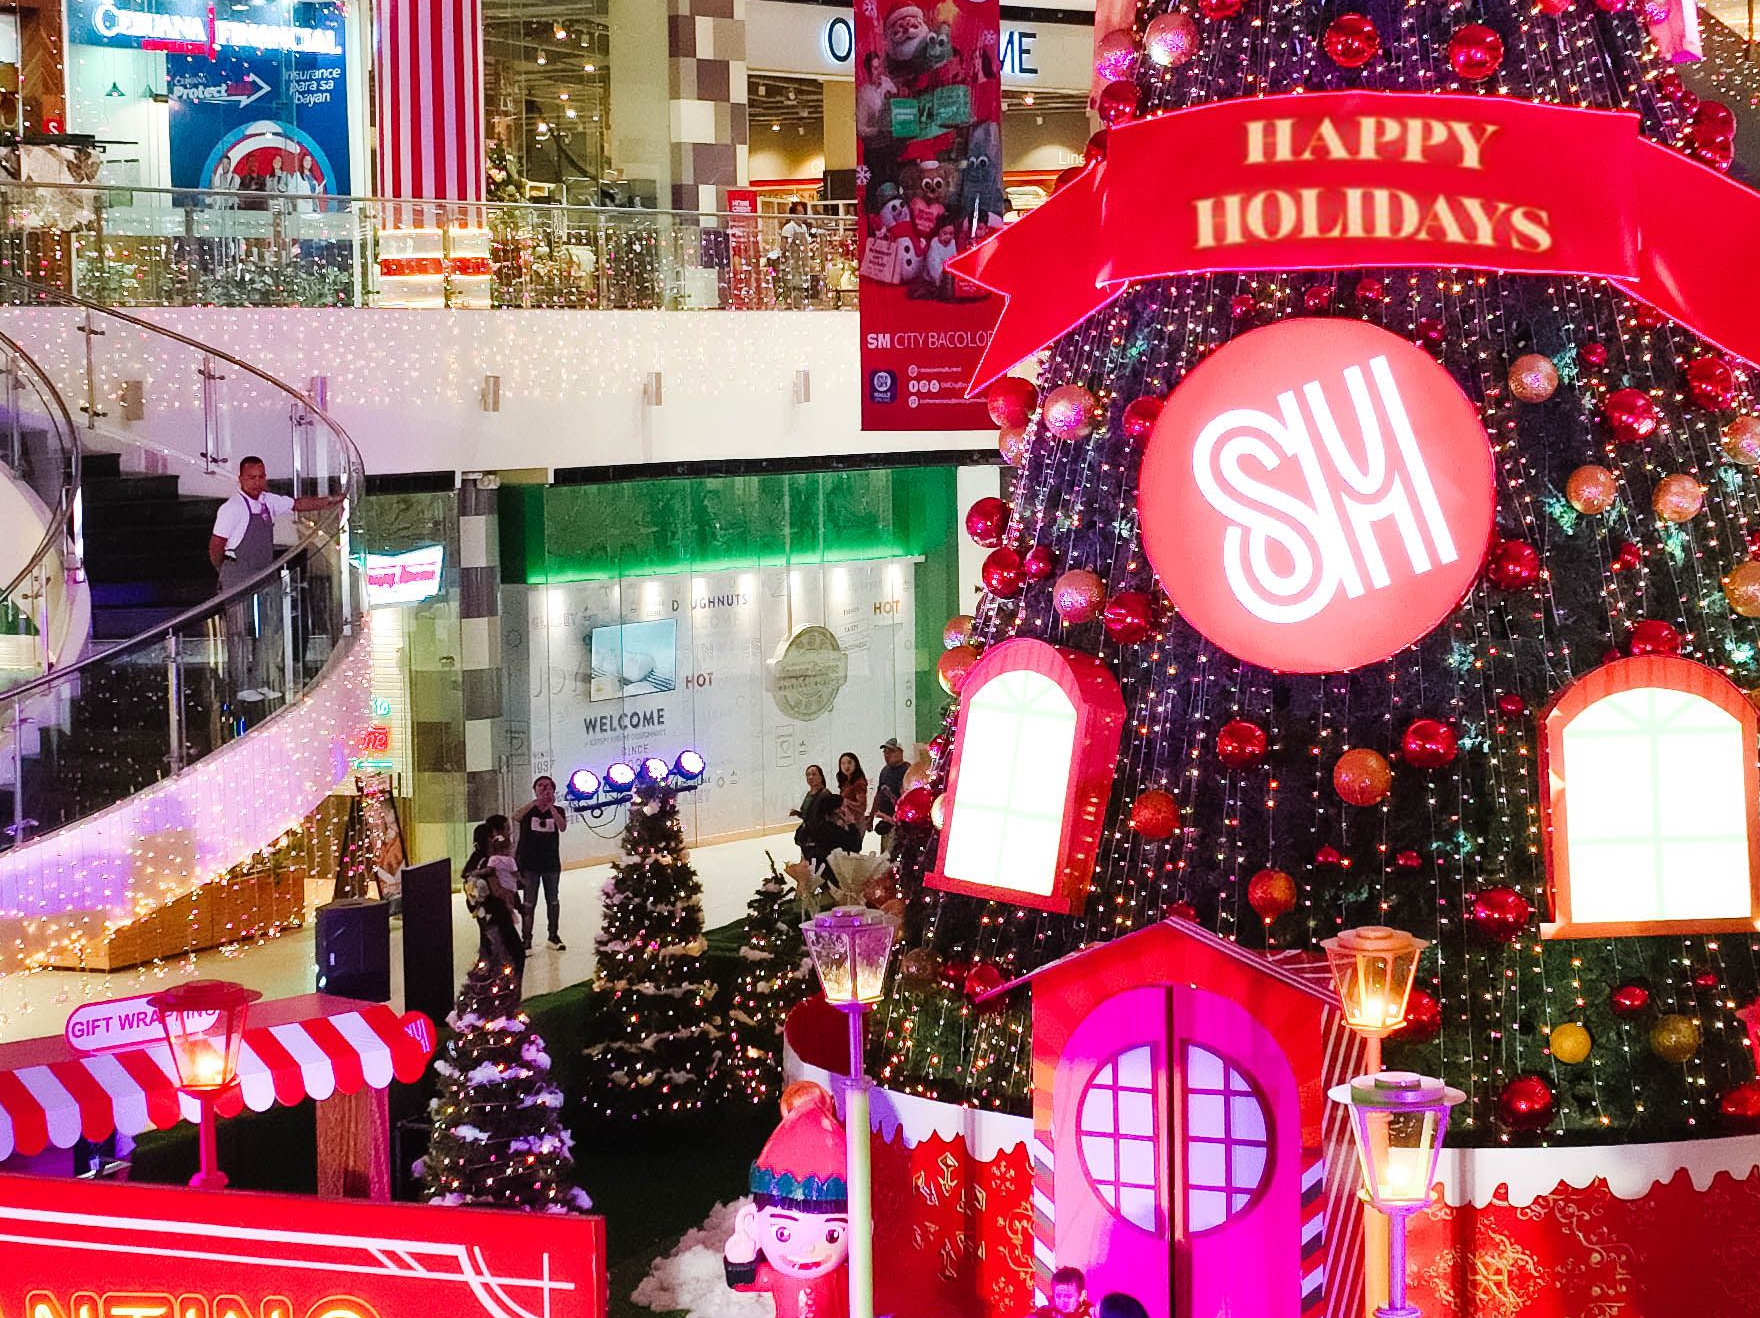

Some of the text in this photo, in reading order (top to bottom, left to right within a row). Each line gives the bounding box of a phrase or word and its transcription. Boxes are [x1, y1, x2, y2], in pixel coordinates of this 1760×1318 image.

[1243, 115, 1500, 171] HAPPY
[1190, 185, 1554, 254] HOLIDAYS
[866, 332, 891, 349] SM
[894, 332, 926, 349] CITY
[1190, 353, 1460, 625] SM
[872, 599, 901, 615] HOT
[684, 671, 715, 690] HOT
[583, 707, 666, 735] WELCOME
[71, 1016, 114, 1040] GIFT
